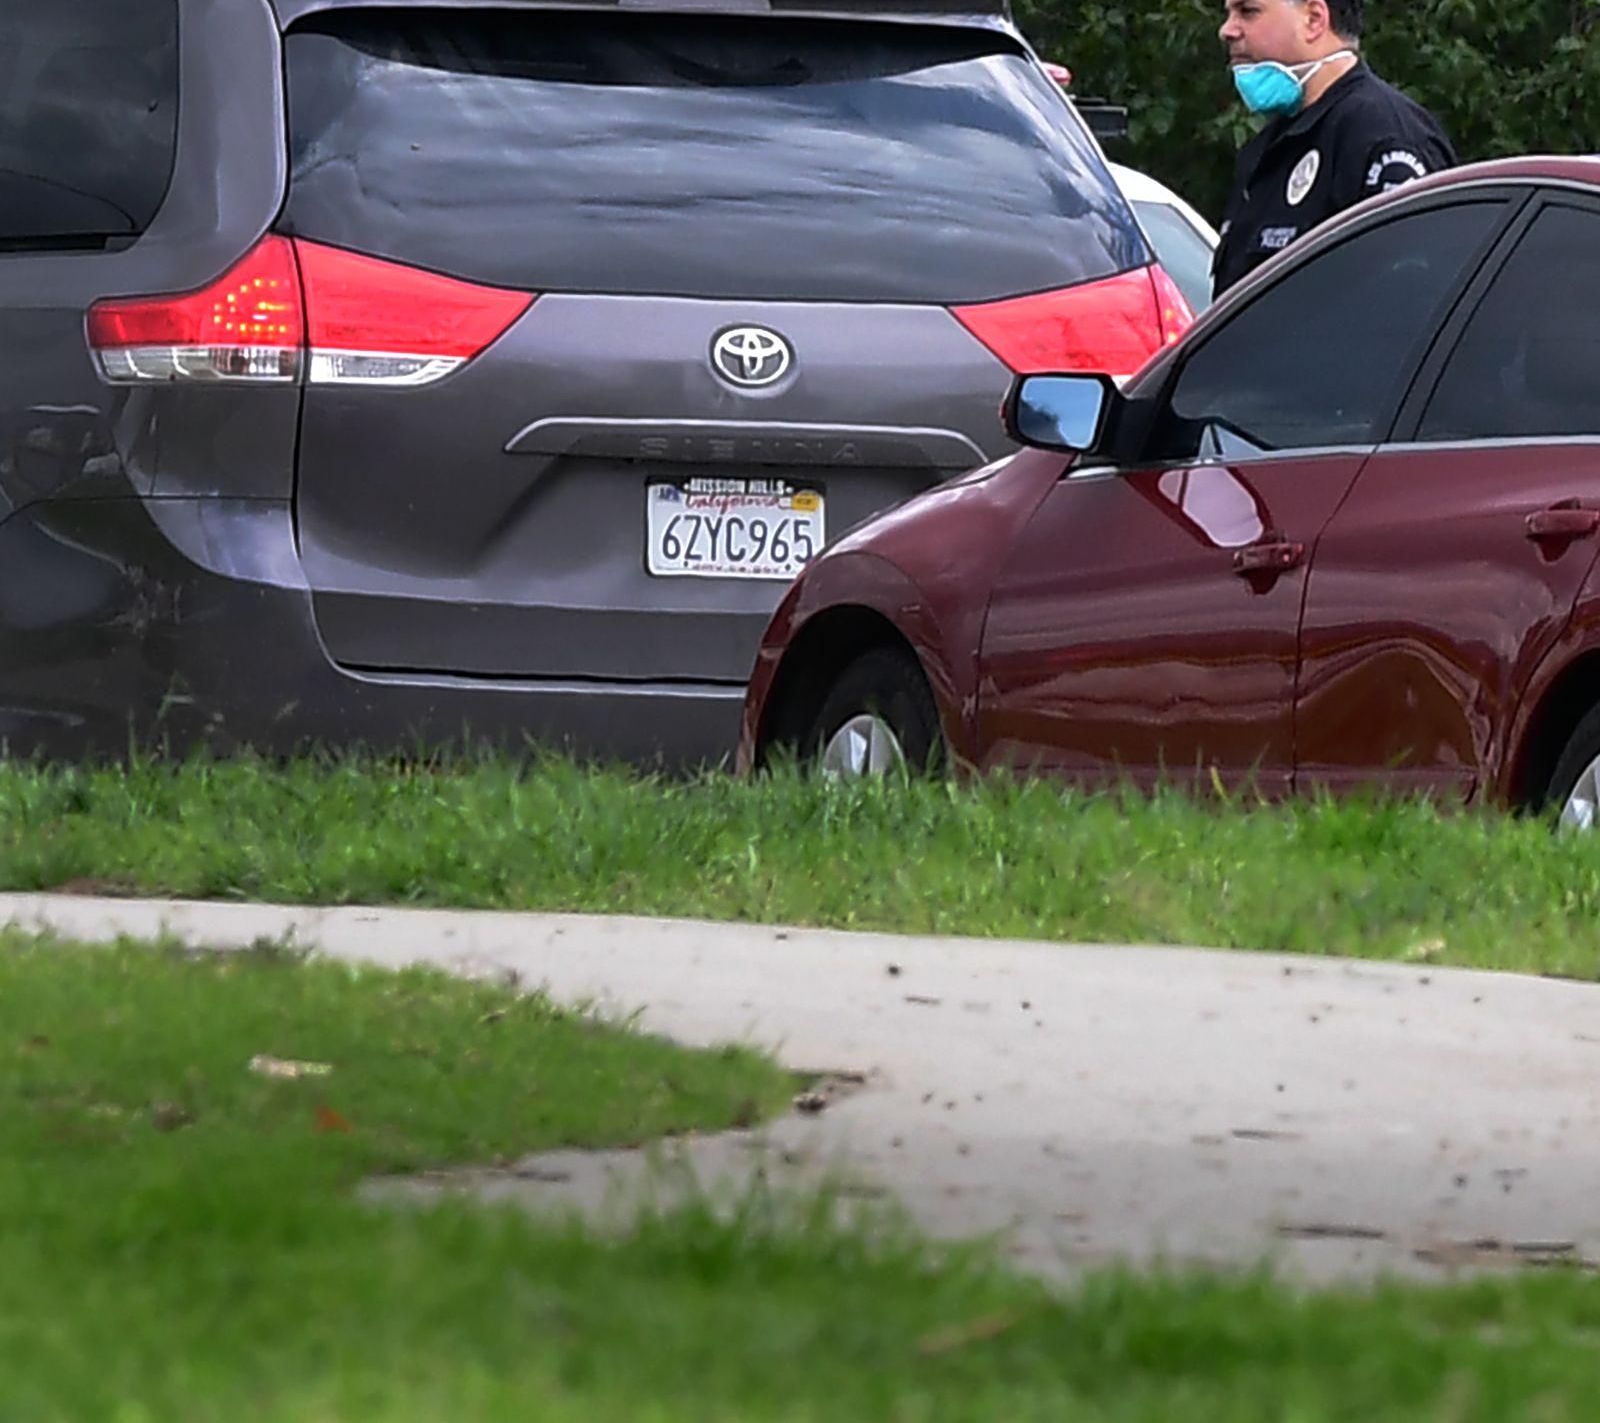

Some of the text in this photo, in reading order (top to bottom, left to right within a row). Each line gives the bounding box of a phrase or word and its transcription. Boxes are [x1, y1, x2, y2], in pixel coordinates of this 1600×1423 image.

[690, 478, 784, 494] MISSION HILLS
[686, 493, 790, 514] California
[662, 515, 813, 562] 6ZYC965
